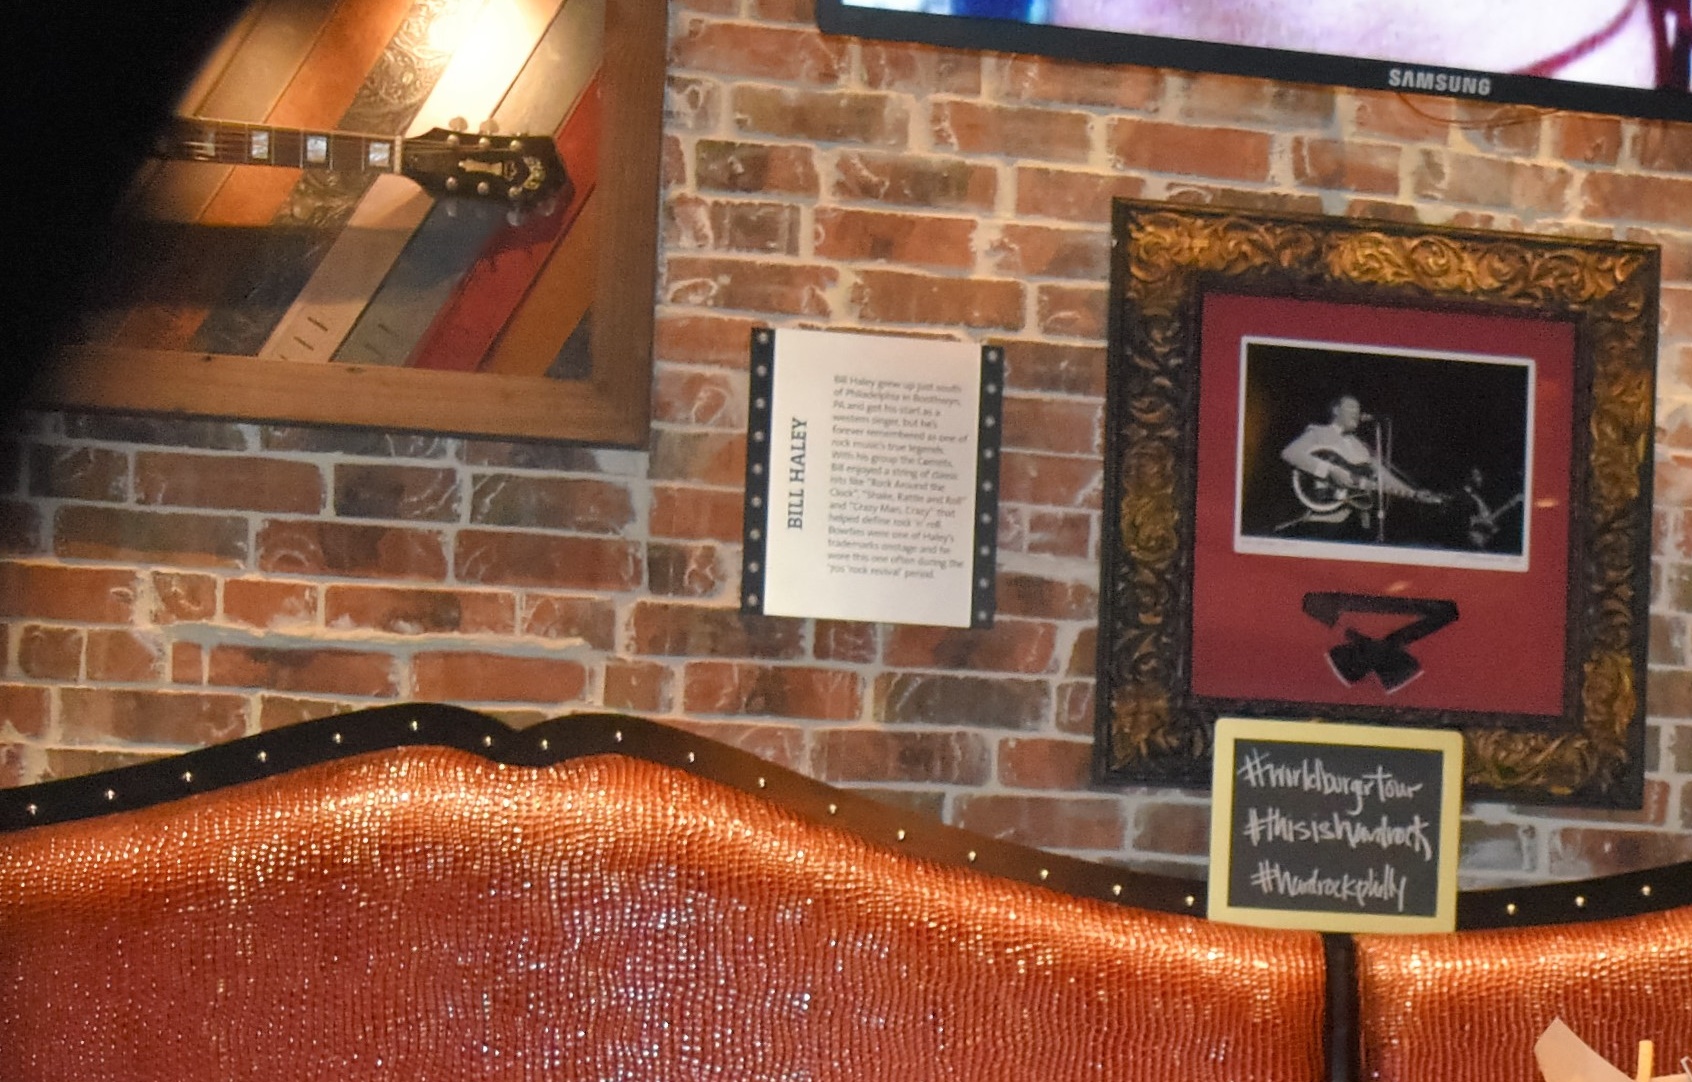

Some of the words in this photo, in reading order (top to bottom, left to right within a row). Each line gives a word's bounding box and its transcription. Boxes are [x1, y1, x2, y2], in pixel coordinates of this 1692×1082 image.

[1389, 68, 1491, 95] SAMSUNG
[850, 377, 874, 388] Haley
[789, 416, 807, 483] HALEY
[787, 488, 804, 529] BILL
